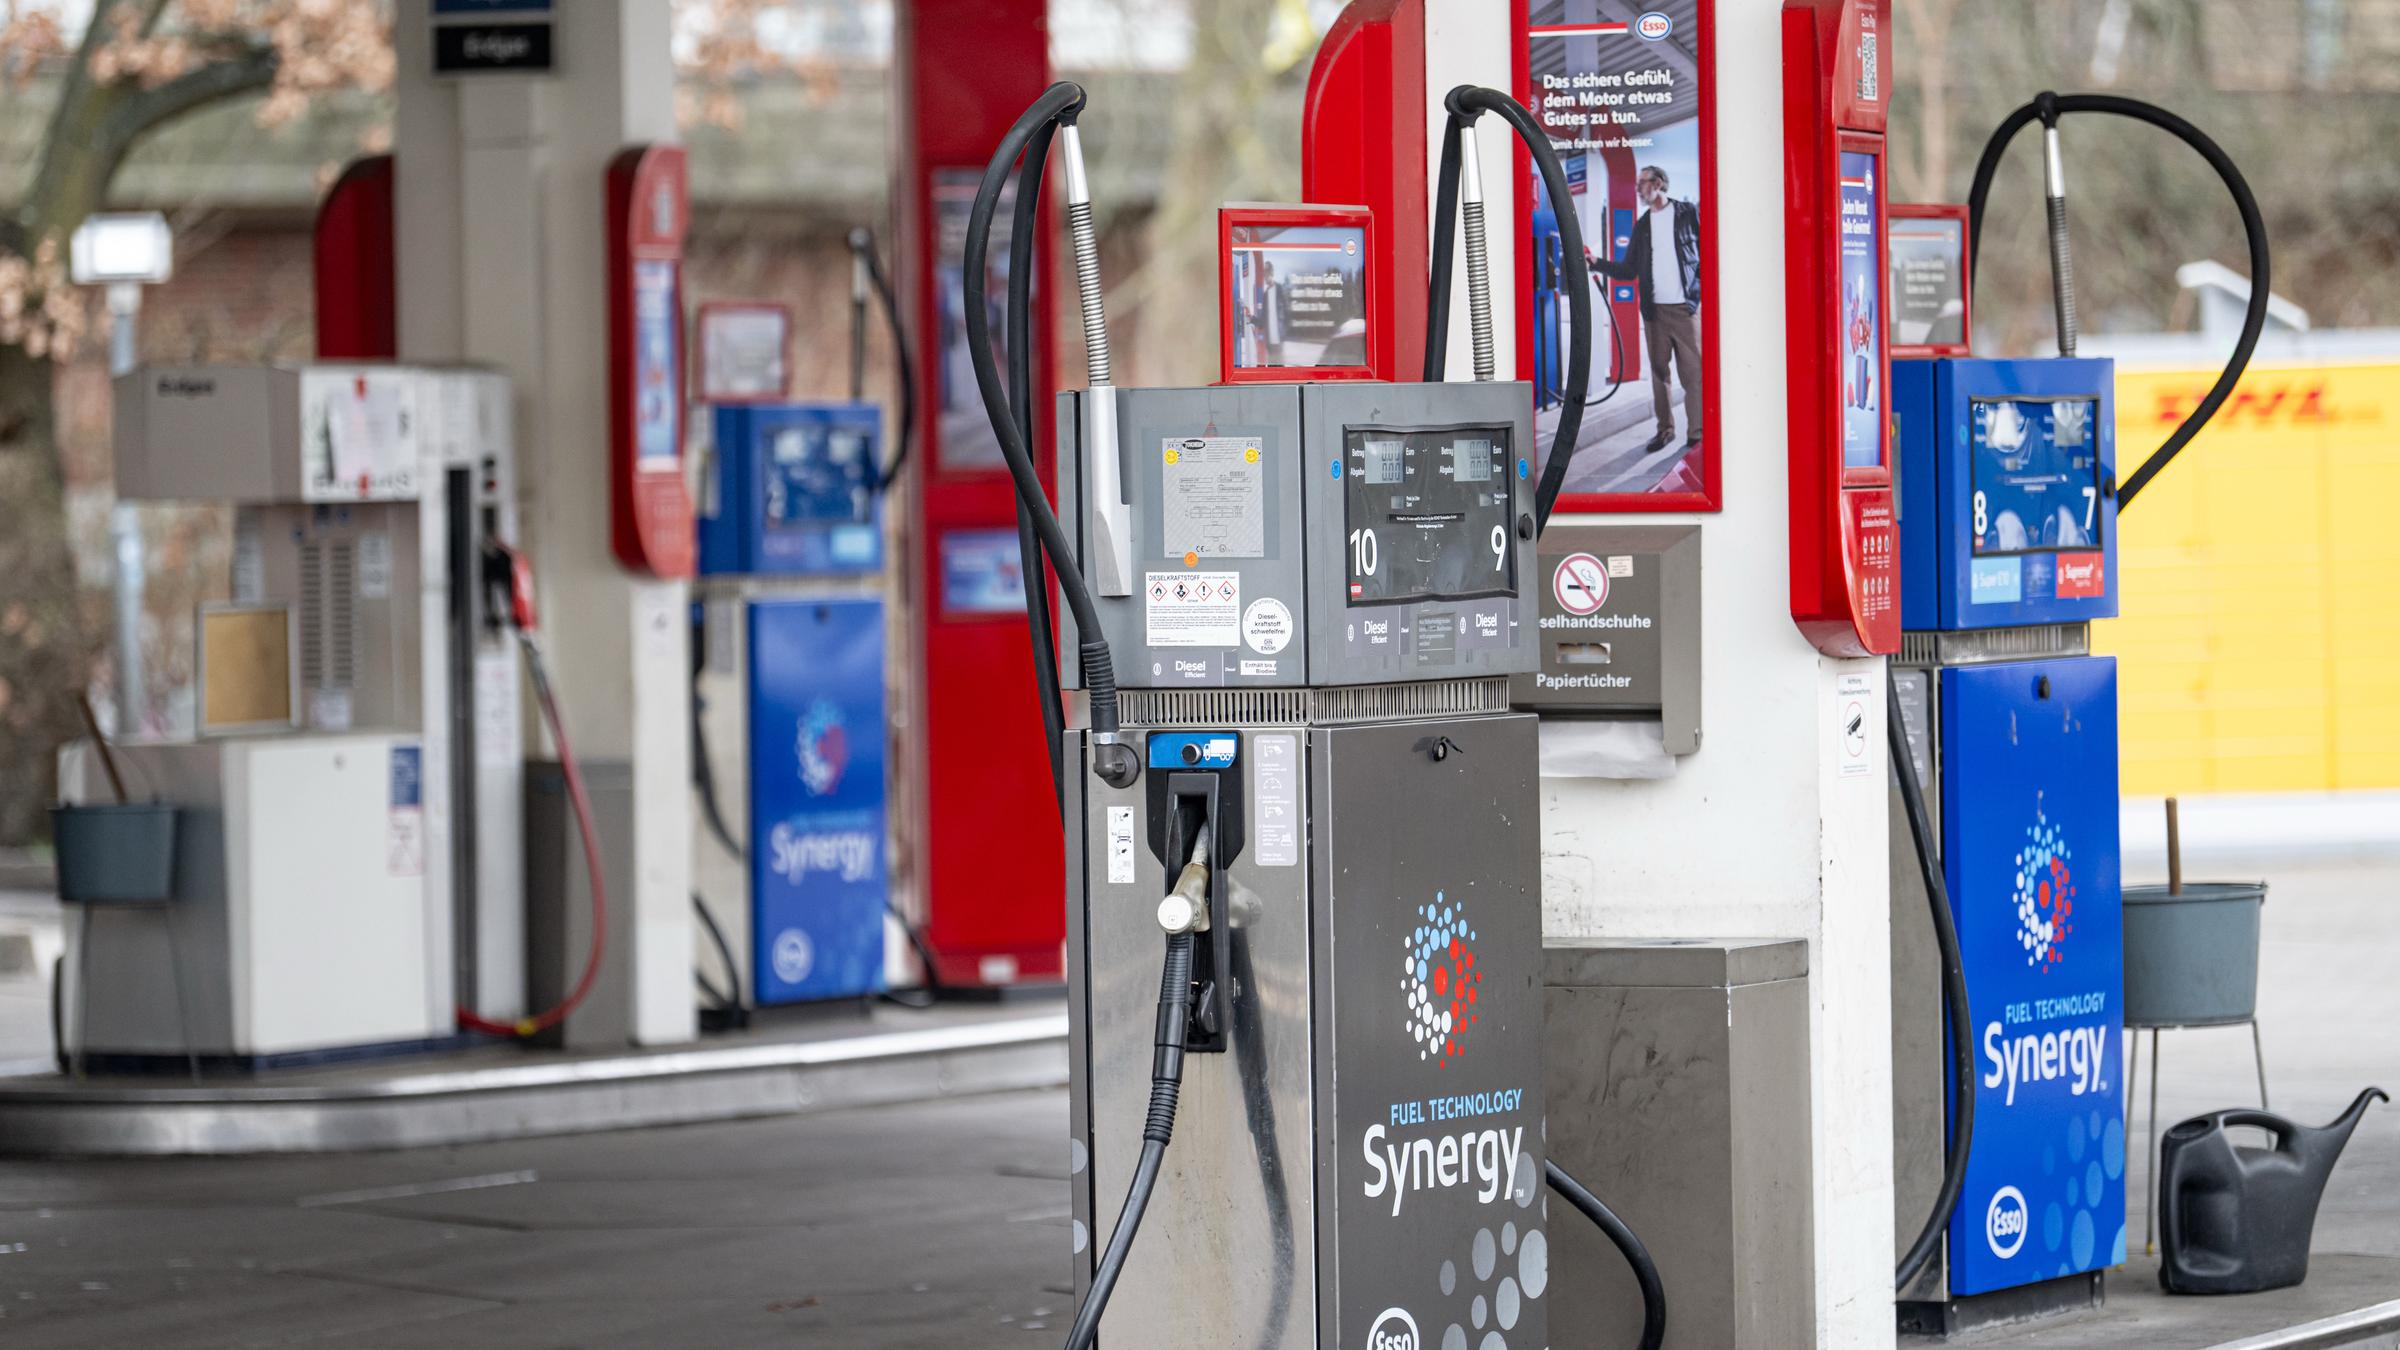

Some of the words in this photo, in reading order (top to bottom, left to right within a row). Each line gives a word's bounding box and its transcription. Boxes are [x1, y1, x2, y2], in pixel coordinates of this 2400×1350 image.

[1642, 20, 1666, 32] Esso
[1543, 74, 1569, 89] Das
[1573, 72, 1621, 88] sichere
[1624, 69, 1674, 87] Gefühl,
[1543, 93, 1575, 108] dem
[1579, 91, 1625, 107] Motor
[1628, 90, 1672, 105] etwas
[1543, 111, 1587, 127] Gutes
[1591, 113, 1608, 125] zu
[1611, 111, 1640, 124] tun.
[1551, 138, 1572, 150] amit
[1574, 138, 1604, 149] fahren
[1605, 137, 1620, 148] wir
[1622, 137, 1653, 148] besser.
[1974, 490, 1988, 536] 8
[2082, 486, 2096, 530] 7
[1350, 528, 1378, 577] 10
[1490, 525, 1506, 572] 9
[1364, 620, 1388, 635] Diesel
[1475, 613, 1497, 628] Diesel
[1539, 614, 1651, 629] selhandschuhe
[1371, 636, 1388, 644] Efficient
[1482, 629, 1497, 637] Efficient
[1175, 660, 1206, 671] Diesel
[1536, 674, 1631, 690] Papiertücher
[2006, 1003, 2032, 1025] FUEL
[2035, 992, 2106, 1021] TECHNOLOGY
[1984, 1021, 2107, 1106] Synergy
[1391, 1101, 1425, 1126] FUEL
[1429, 1088, 1523, 1121] TECHNOLOGY
[1363, 1123, 1523, 1217] Synergy
[1993, 1206, 2022, 1237] Esso
